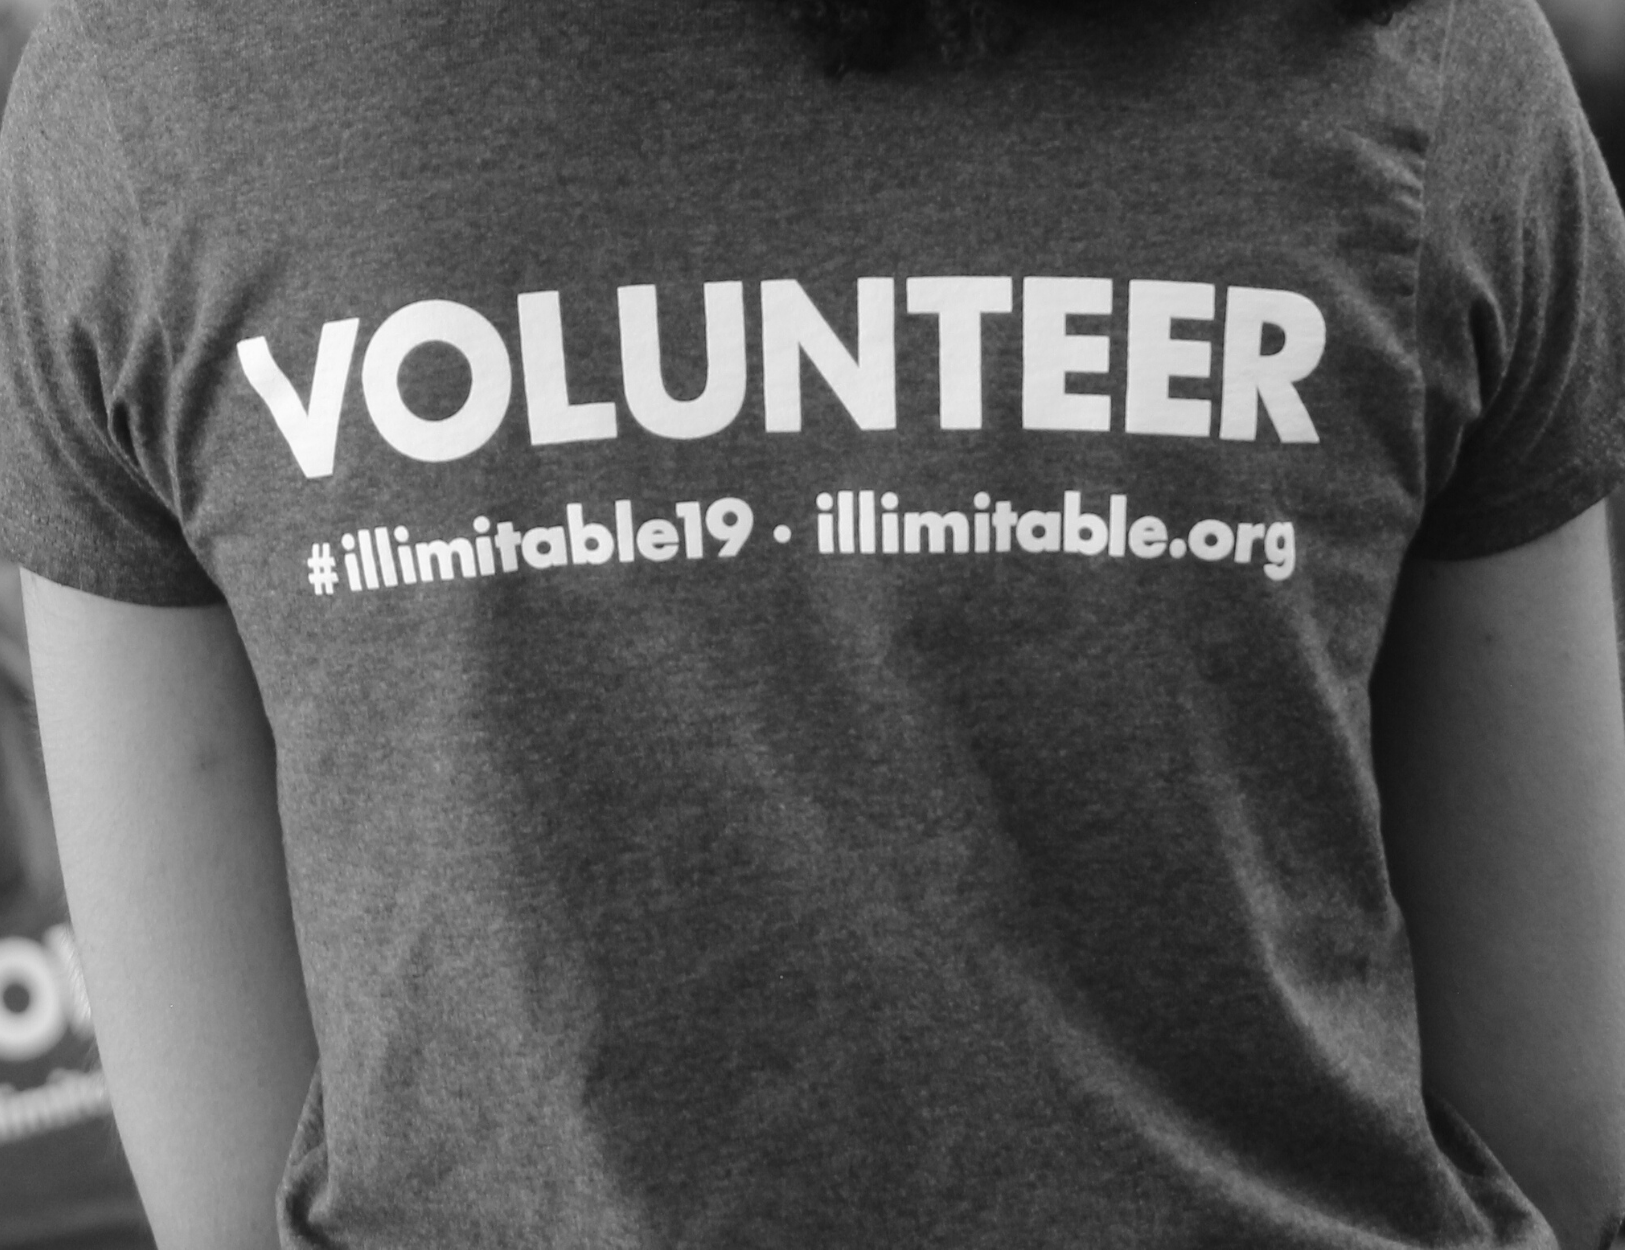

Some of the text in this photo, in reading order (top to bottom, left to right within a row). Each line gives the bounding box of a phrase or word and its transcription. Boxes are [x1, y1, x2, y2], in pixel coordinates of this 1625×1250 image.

[235, 275, 1327, 480] VOLUNTEER
[305, 497, 755, 596] #illimitable19
[816, 490, 1297, 581] illimitable.org
